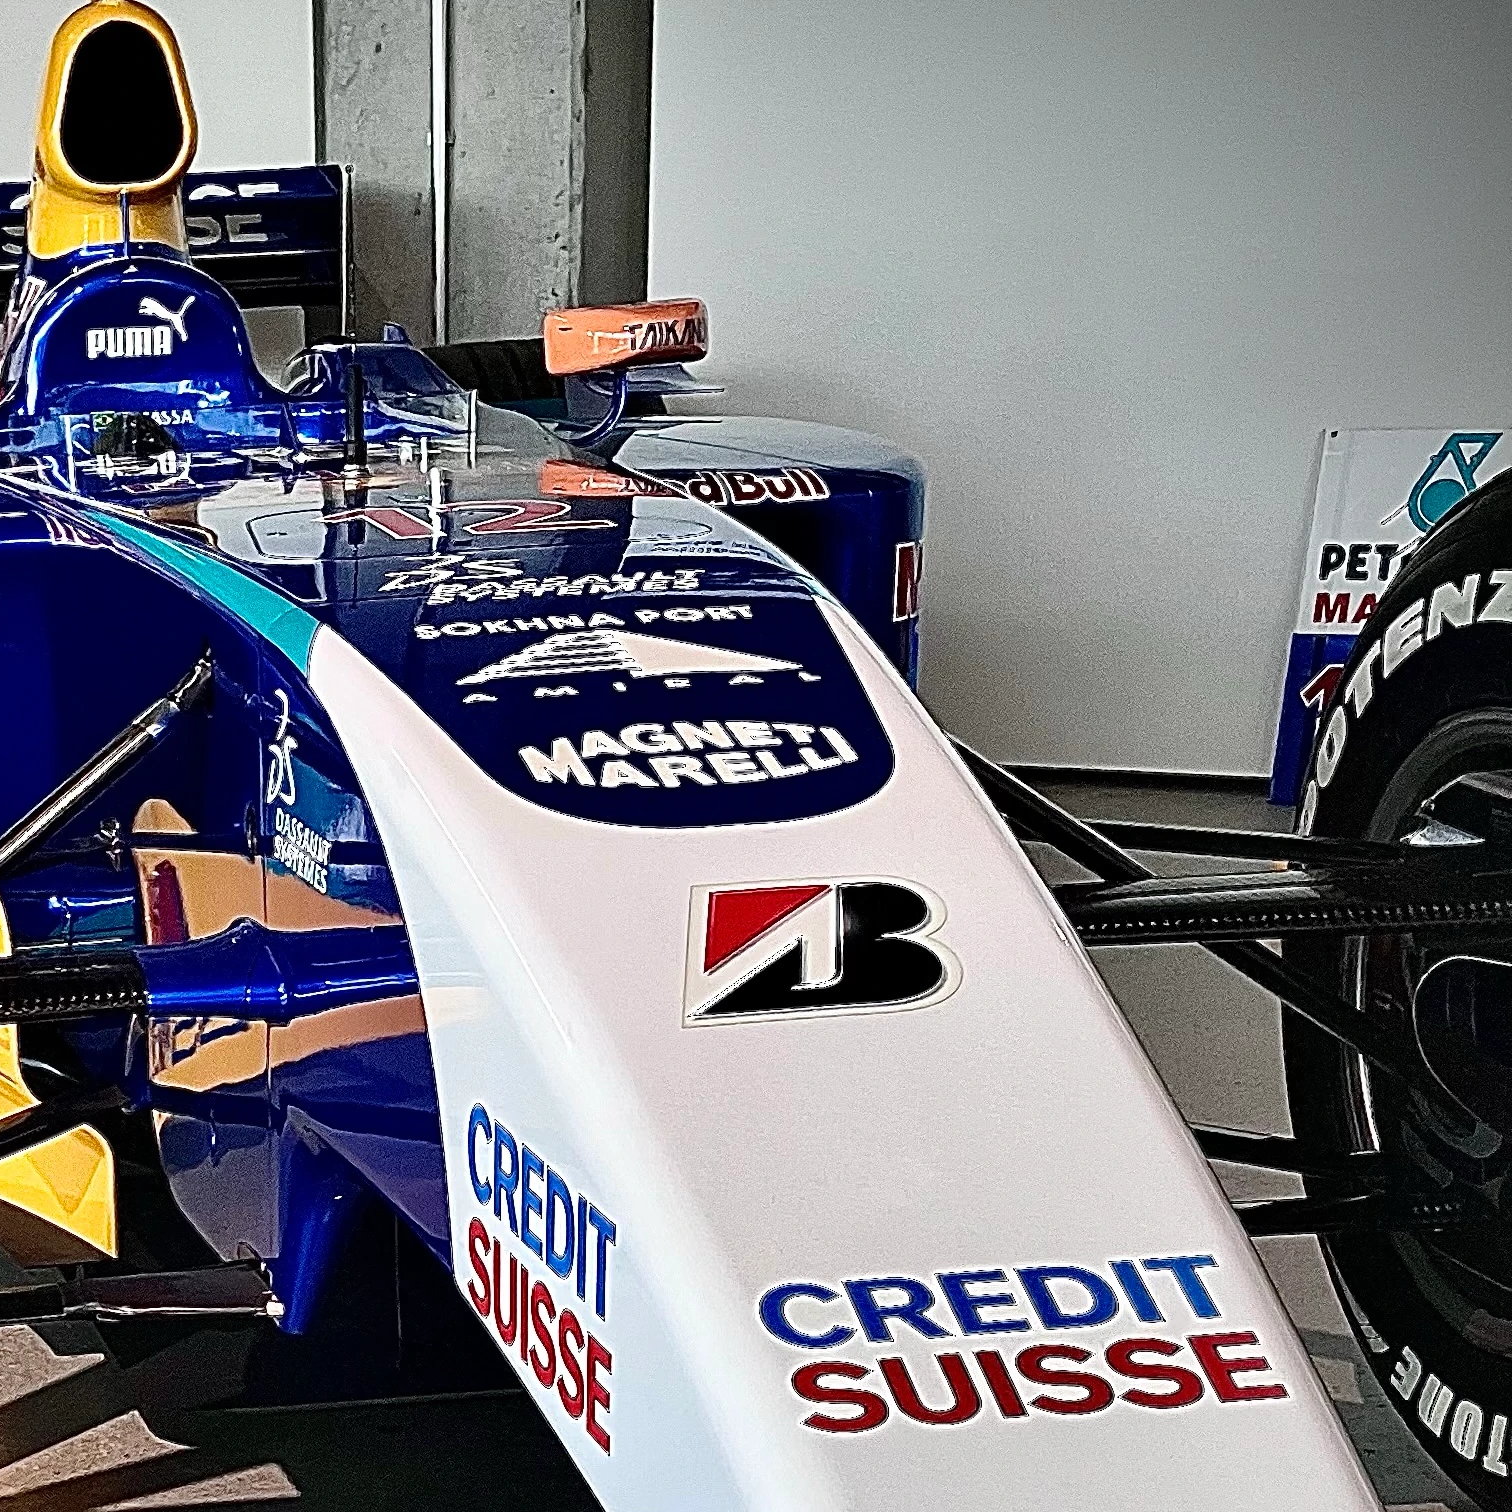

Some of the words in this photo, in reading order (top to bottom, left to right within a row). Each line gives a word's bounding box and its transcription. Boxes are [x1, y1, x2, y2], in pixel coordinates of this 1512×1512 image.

[86, 326, 173, 359] PUMA
[1318, 543, 1402, 581] PET
[413, 612, 626, 640] SOKHNA
[634, 604, 754, 625] PORT
[1312, 592, 1381, 624] MA
[275, 807, 332, 866] DASSAULT
[466, 1102, 617, 1322] CREDIT
[757, 1253, 1223, 1349] CREDIT
[467, 1216, 613, 1457] SUISSE
[790, 1330, 1291, 1434] SUISSE
